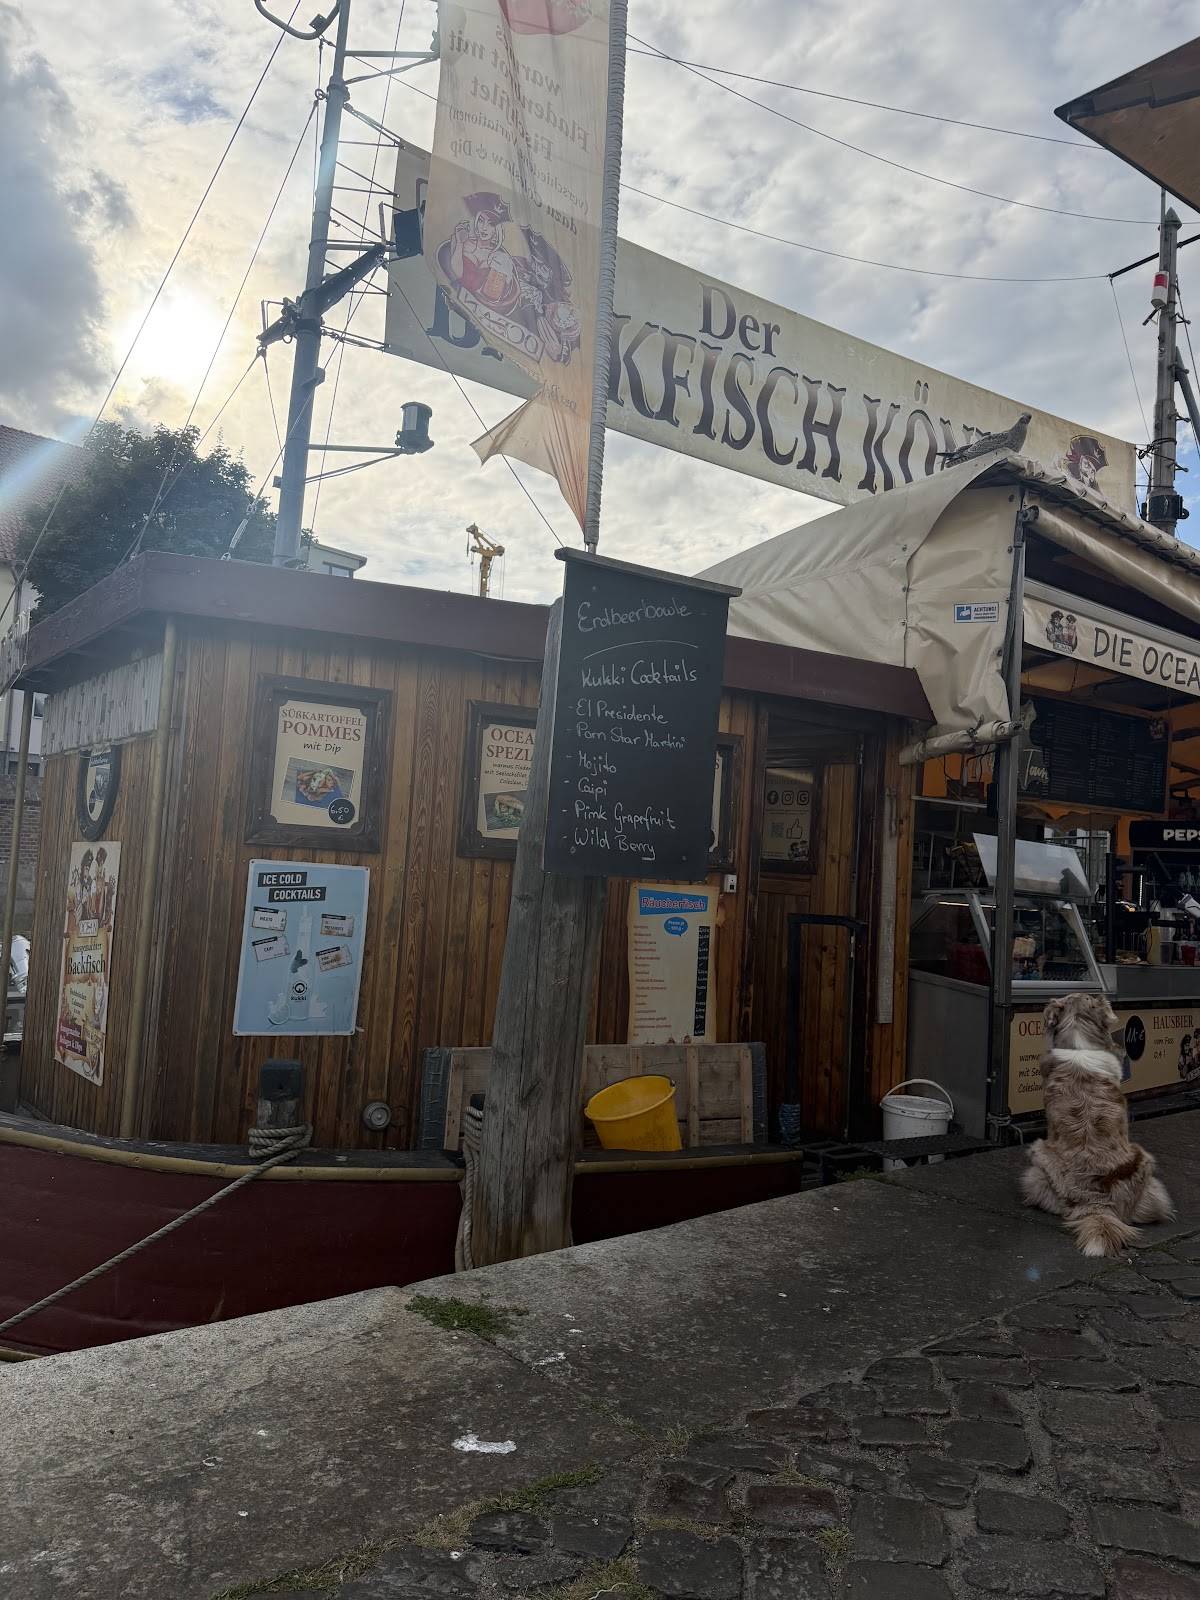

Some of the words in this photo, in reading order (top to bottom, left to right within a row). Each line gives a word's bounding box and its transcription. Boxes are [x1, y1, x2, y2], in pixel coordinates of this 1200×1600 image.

[698, 280, 781, 358] Der
[577, 597, 692, 632] Erdbeerbowle
[1093, 626, 1134, 668] DIE
[581, 663, 626, 688] Kukki
[630, 659, 697, 685] Cocktails
[576, 698, 592, 717] El
[596, 700, 669, 724] Presidente
[281, 720, 361, 742] POMMES
[576, 721, 607, 740] Porn
[610, 726, 641, 744] Star
[303, 742, 321, 752] mit
[324, 743, 342, 755] Dip
[578, 750, 617, 776] Mojito
[578, 777, 608, 802] Caipi
[574, 800, 608, 820] Pink
[614, 802, 677, 833] Grapefruit
[574, 827, 611, 850] Wild
[614, 834, 656, 861] Berry
[1163, 828, 1200, 842] PEP
[263, 874, 277, 885] ICE
[279, 874, 302, 885] COLD
[273, 888, 321, 901] COCKTAILS
[67, 953, 106, 976] Backfisch
[1152, 1014, 1194, 1030] HAUSBIER
